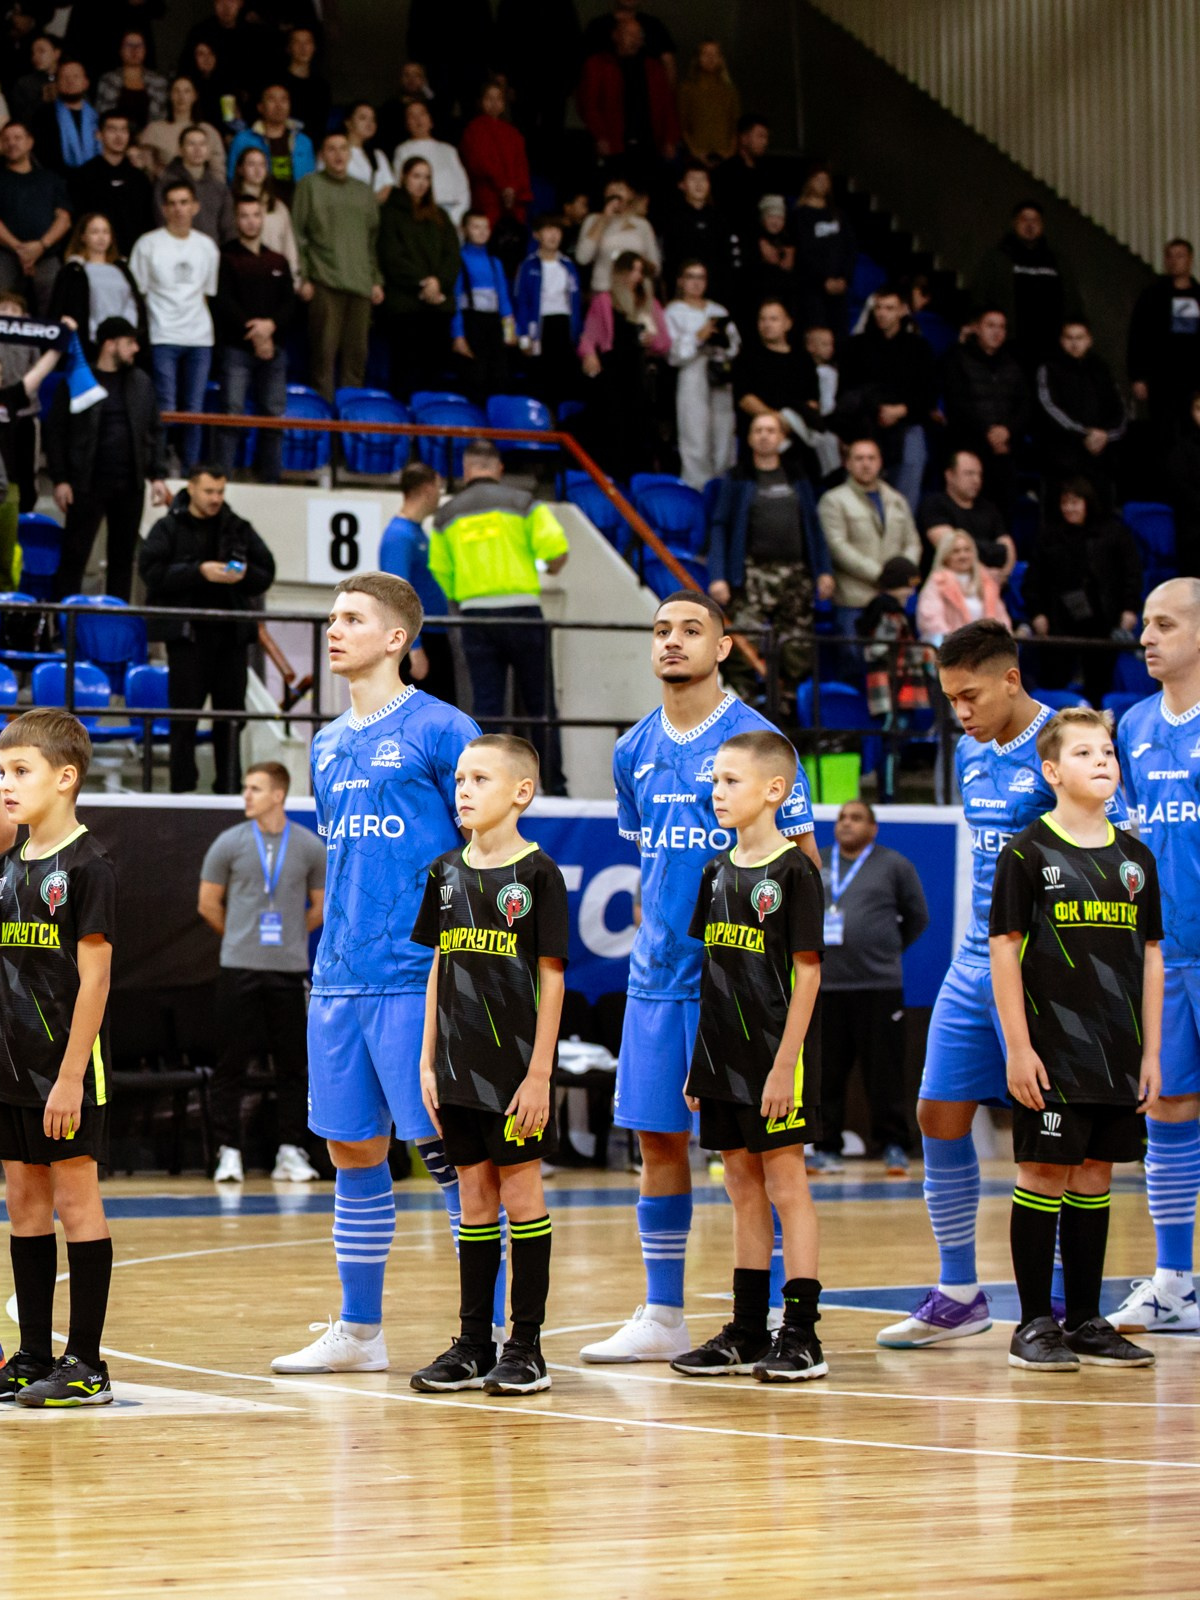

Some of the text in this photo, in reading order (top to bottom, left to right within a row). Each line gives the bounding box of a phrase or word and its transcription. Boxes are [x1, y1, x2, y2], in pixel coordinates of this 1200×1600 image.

[329, 511, 360, 572] 8
[370, 760, 402, 769] ИРАЭРО
[695, 775, 714, 783] ИРА
[641, 825, 731, 851] RAERO
[1055, 901, 1081, 922] ФК
